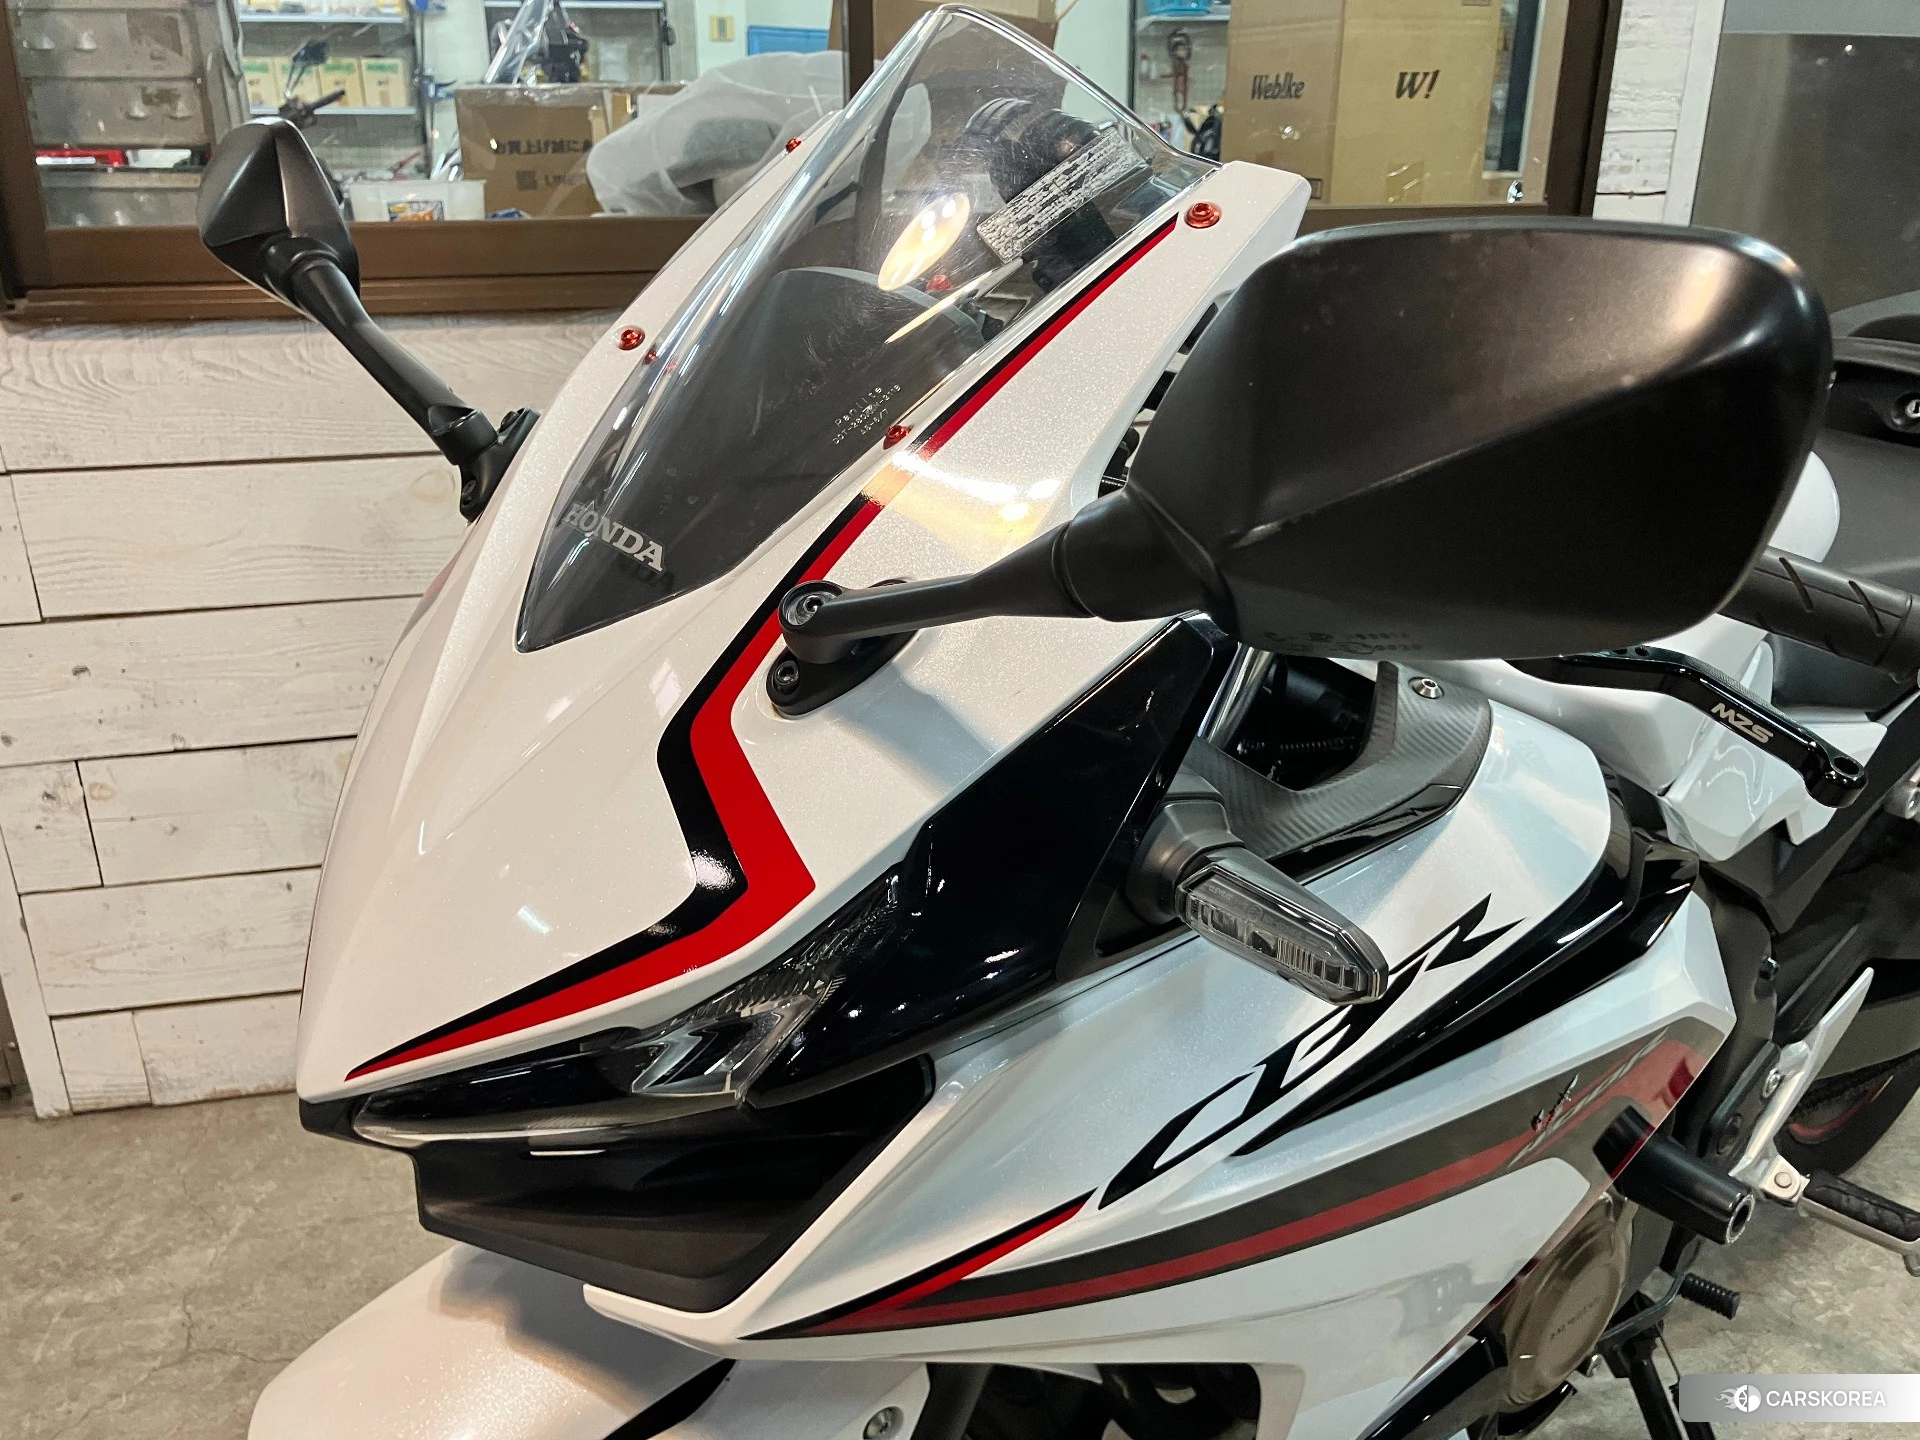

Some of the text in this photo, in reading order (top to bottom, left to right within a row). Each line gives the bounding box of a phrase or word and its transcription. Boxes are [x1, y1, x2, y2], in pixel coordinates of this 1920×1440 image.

[1395, 69, 1440, 99] W!
[561, 499, 665, 573] HONDA
[1710, 702, 1774, 744] MZS
